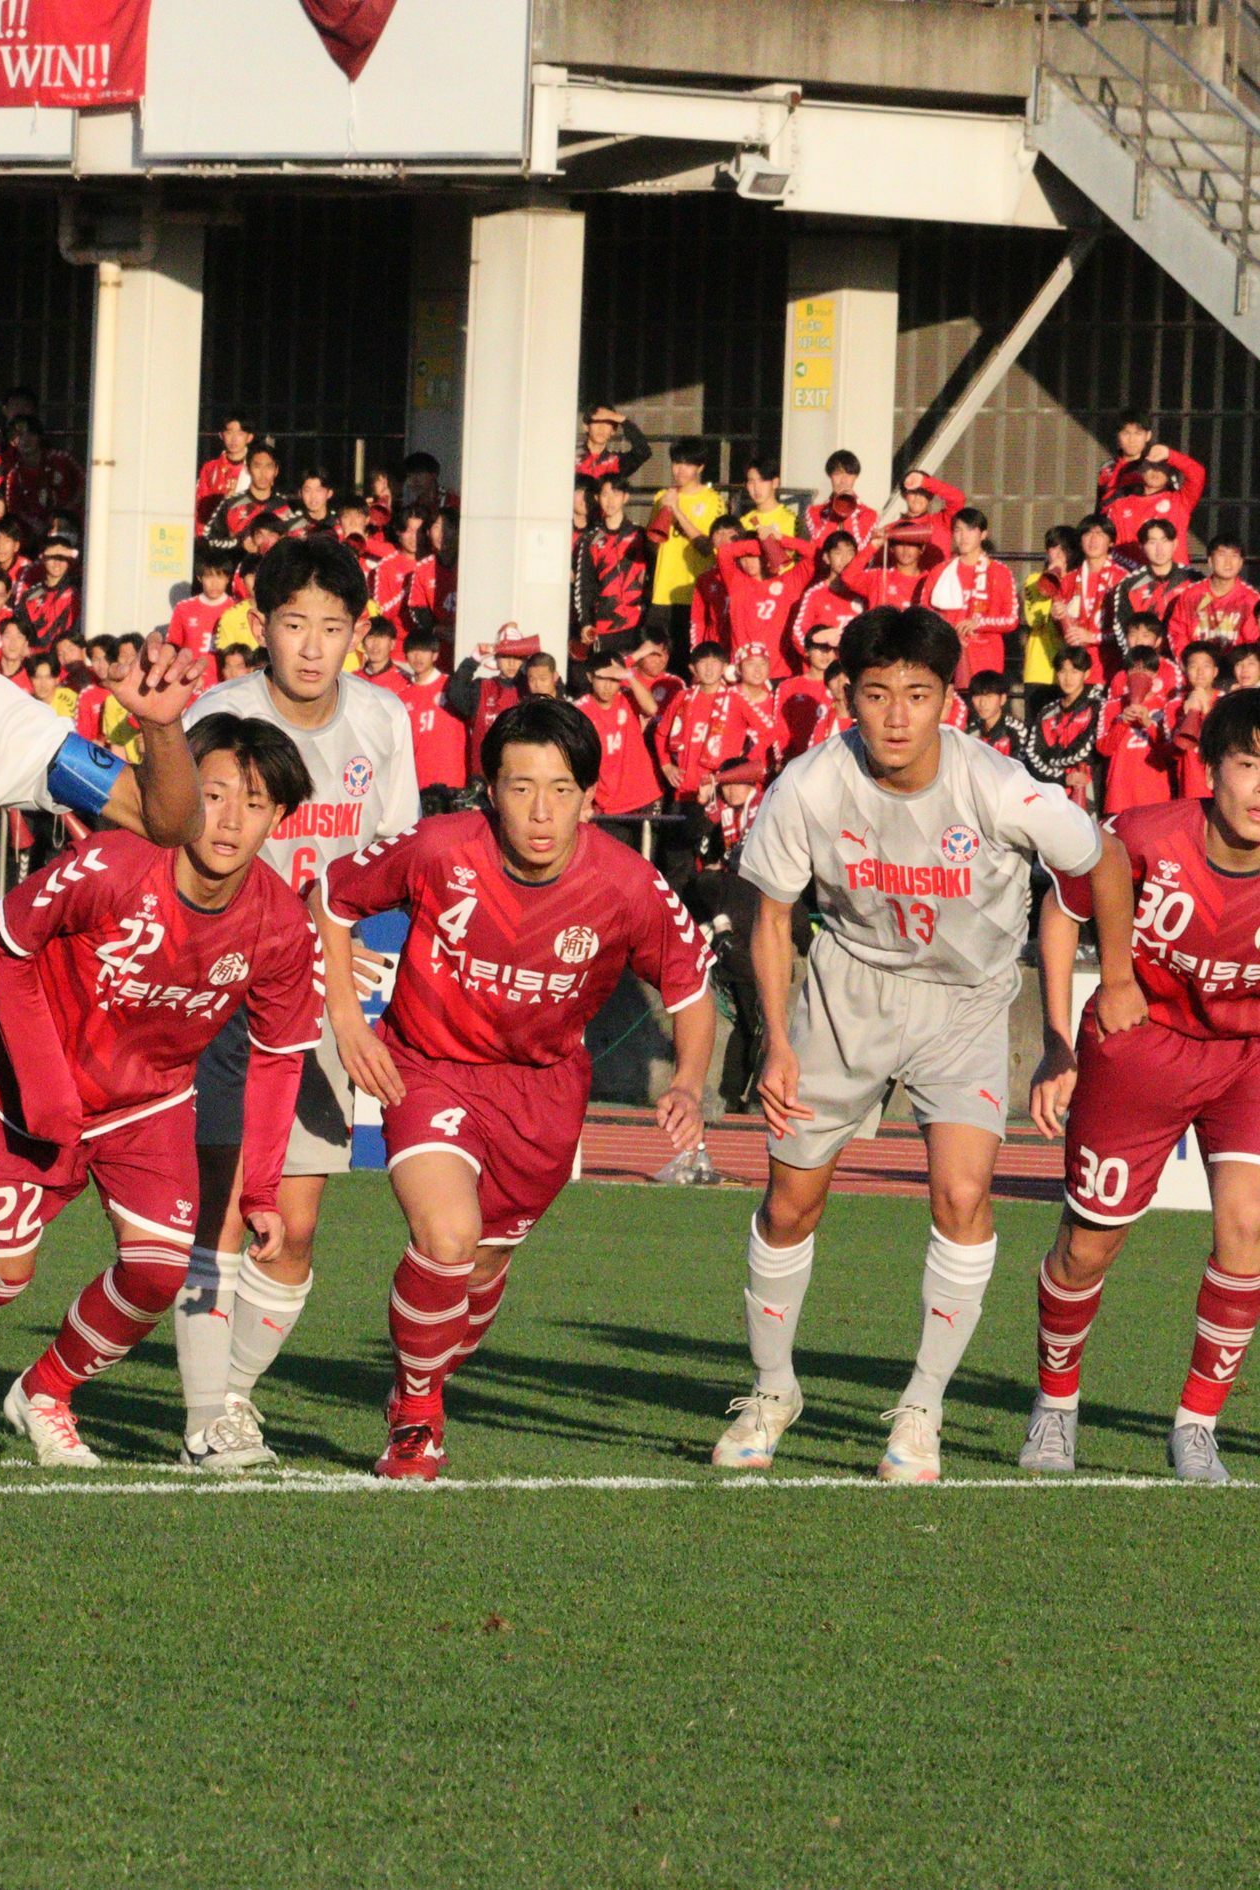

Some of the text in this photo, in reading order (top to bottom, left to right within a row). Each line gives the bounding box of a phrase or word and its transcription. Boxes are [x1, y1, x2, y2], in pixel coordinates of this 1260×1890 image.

[0, 44, 111, 88] WIN!!
[795, 388, 829, 407] EXIT
[291, 846, 317, 892] 6
[845, 859, 971, 899] TSURUSAKI
[437, 896, 478, 944] 4
[885, 898, 934, 945] 13
[1133, 881, 1195, 942] 30
[95, 918, 165, 975] 22
[430, 962, 579, 1005] YAMAGATA
[430, 1106, 467, 1137] 4
[1076, 1144, 1129, 1207] 30
